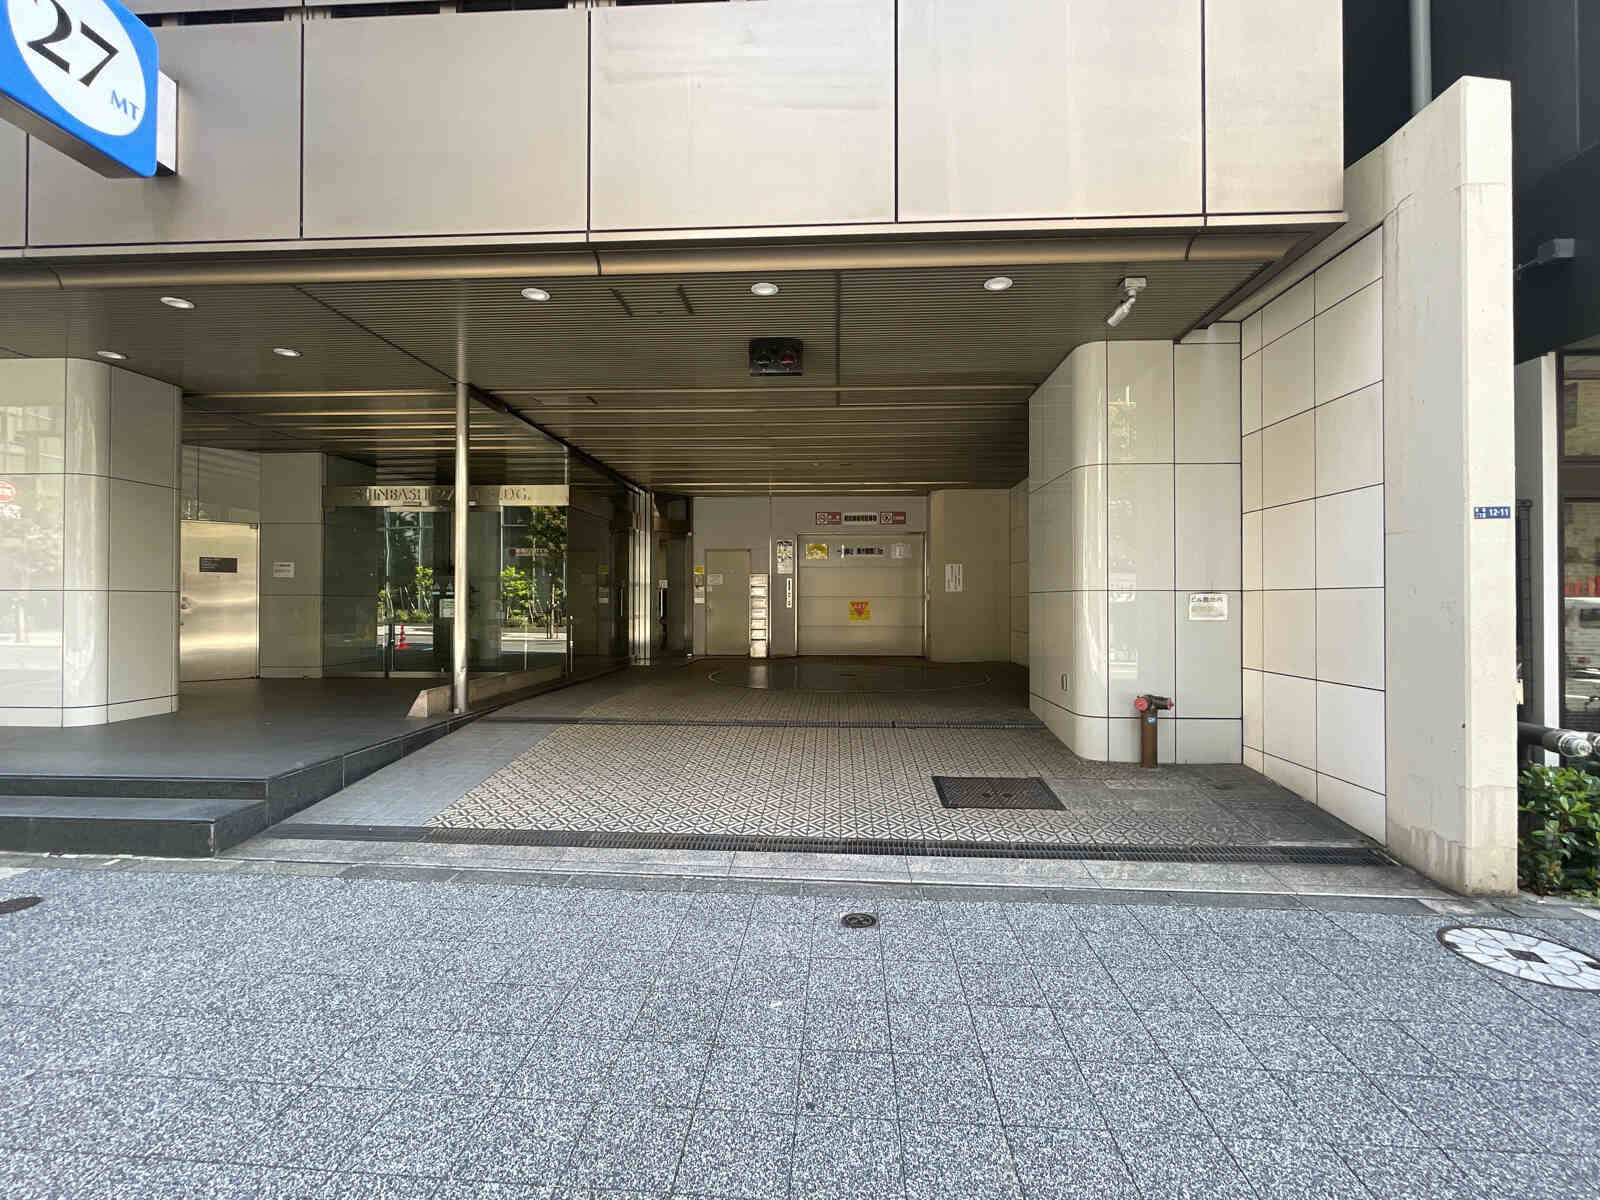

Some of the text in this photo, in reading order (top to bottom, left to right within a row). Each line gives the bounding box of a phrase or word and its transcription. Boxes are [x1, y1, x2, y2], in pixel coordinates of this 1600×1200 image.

[27, 0, 118, 87] 27
[110, 90, 140, 120] MT
[1489, 508, 1509, 517] 12-11
